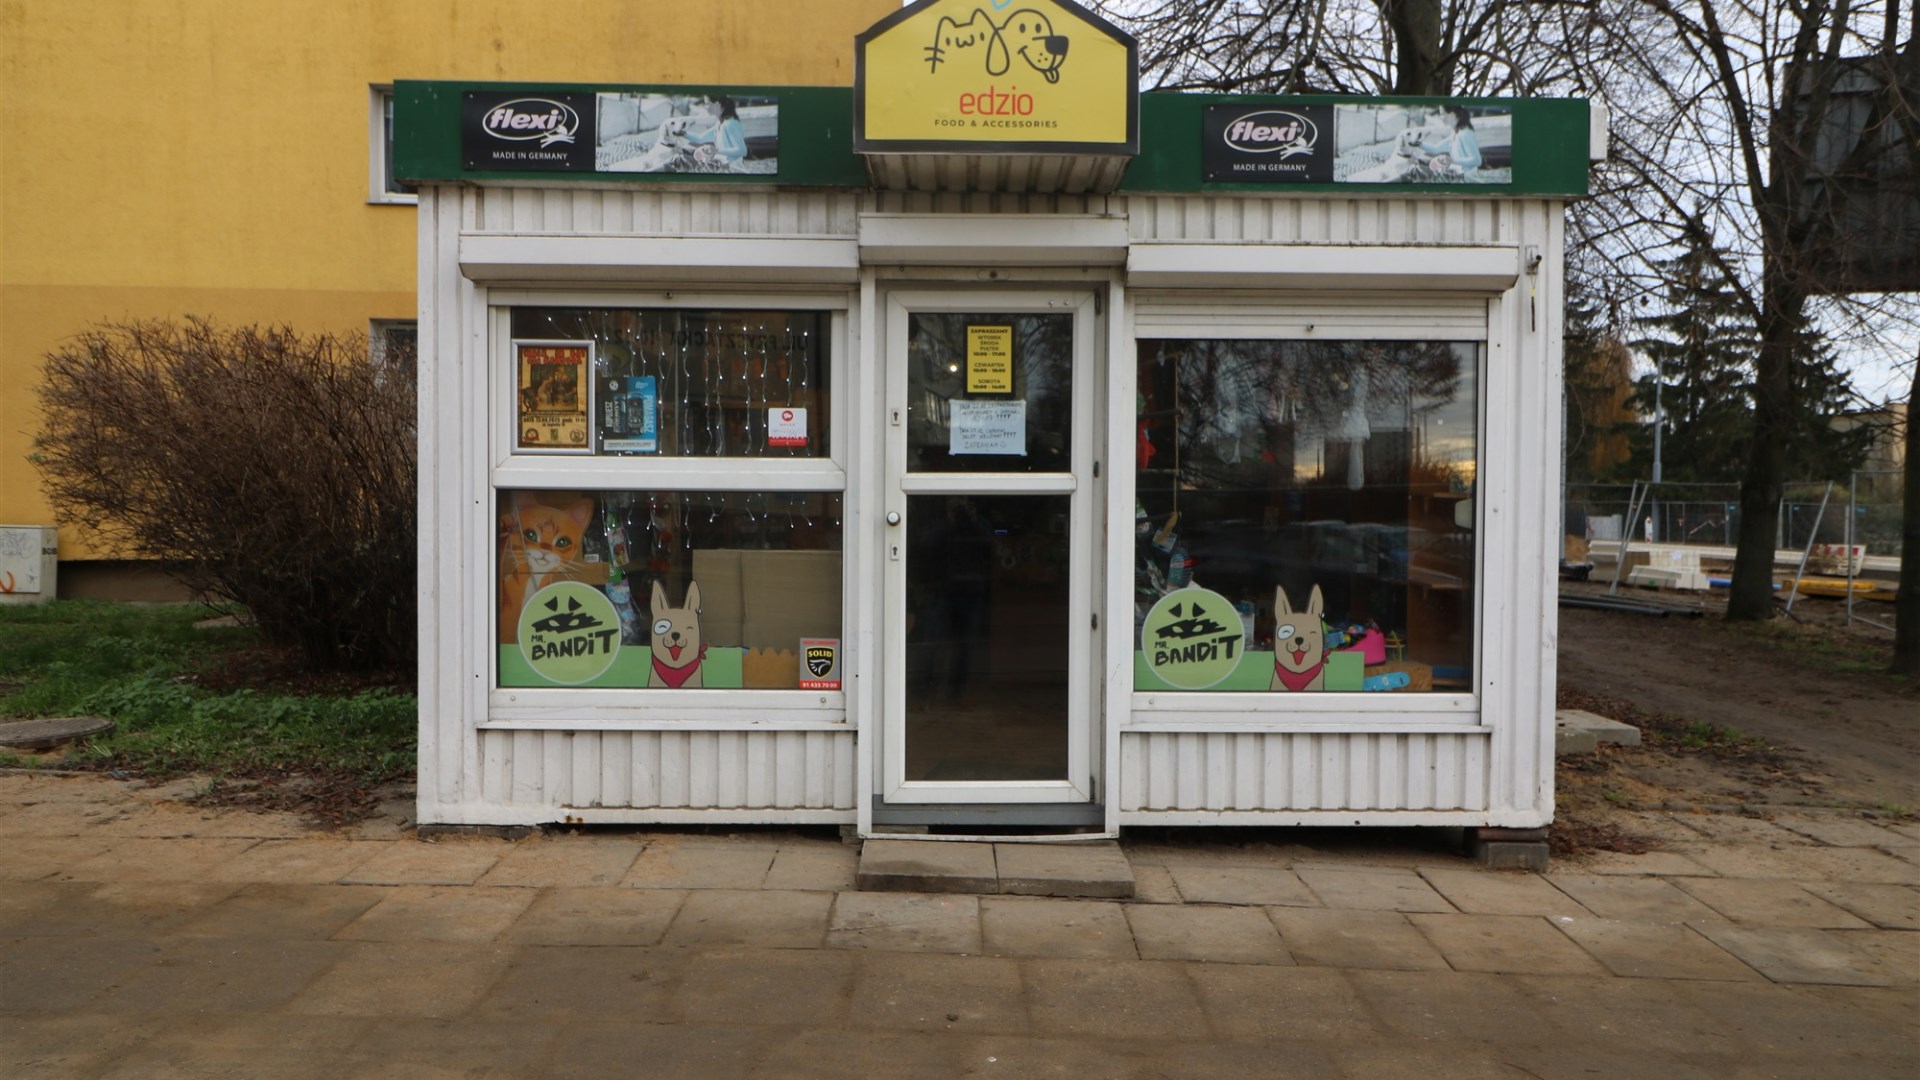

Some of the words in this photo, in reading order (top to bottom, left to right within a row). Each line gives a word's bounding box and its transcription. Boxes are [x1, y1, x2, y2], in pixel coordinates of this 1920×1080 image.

[960, 85, 1033, 116] edzio
[490, 109, 560, 130] flexi
[935, 119, 965, 127] FOOD
[971, 120, 977, 128] &
[983, 120, 1058, 129] ACCESSORIES
[1231, 121, 1298, 141] flexi
[493, 152, 515, 160] MADE
[518, 152, 526, 160] IN
[529, 152, 568, 161] GERMANY
[1268, 164, 1307, 172] GERMANY
[531, 635, 546, 643] MR.
[1154, 640, 1170, 649] MR.
